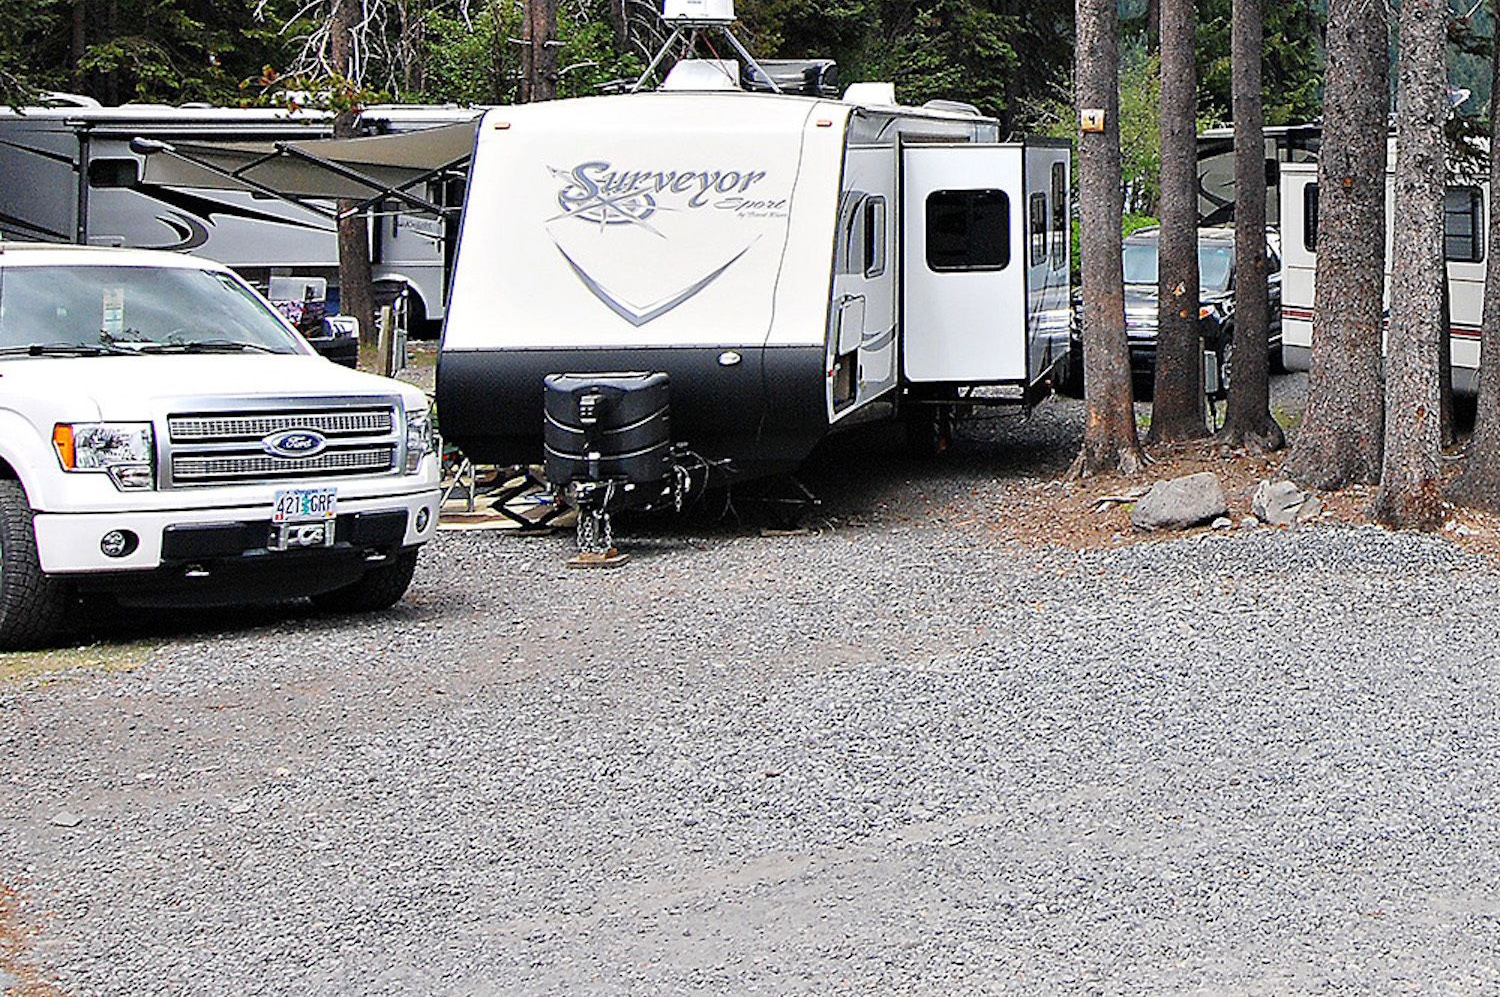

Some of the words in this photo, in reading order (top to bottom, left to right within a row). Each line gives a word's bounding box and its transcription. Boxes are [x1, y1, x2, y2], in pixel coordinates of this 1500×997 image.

[1088, 115, 1095, 125] 4
[558, 161, 767, 209] Surveyor
[713, 197, 787, 212] Sport
[285, 435, 313, 449] Ford
[277, 496, 300, 515] 421
[310, 494, 335, 513] GRF
